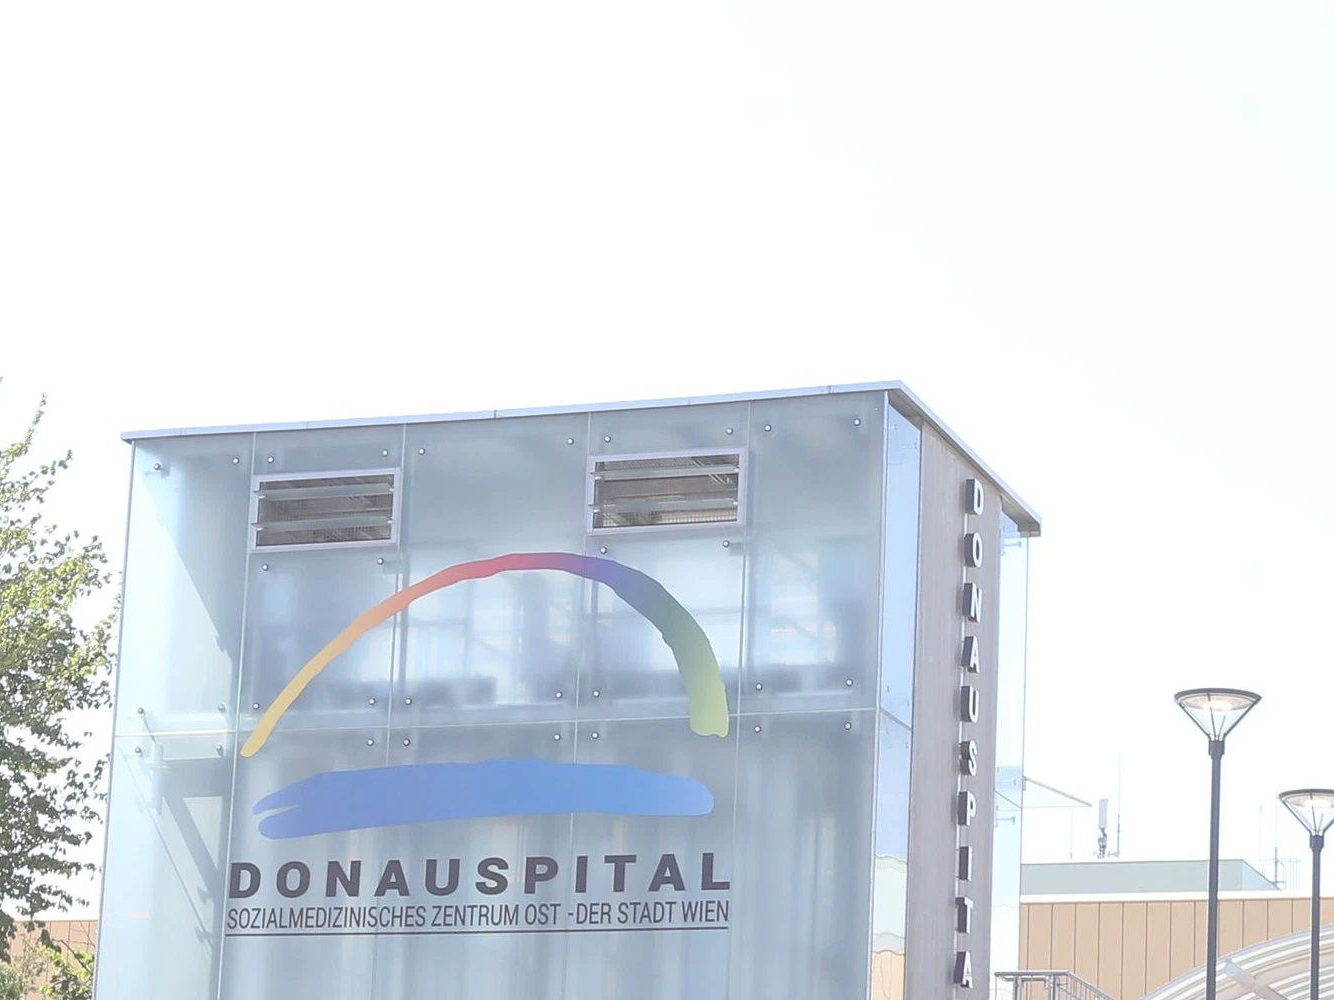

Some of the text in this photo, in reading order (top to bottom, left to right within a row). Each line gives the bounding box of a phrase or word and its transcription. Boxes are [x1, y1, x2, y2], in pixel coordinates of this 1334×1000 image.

[228, 852, 731, 899] DONAUSPITAL
[226, 905, 426, 929] SOZIALMEDIZINISCHES
[431, 903, 518, 927] ZENTRUM
[525, 902, 561, 926] OST
[616, 901, 675, 924] STADT
[680, 900, 729, 923] WIEN
